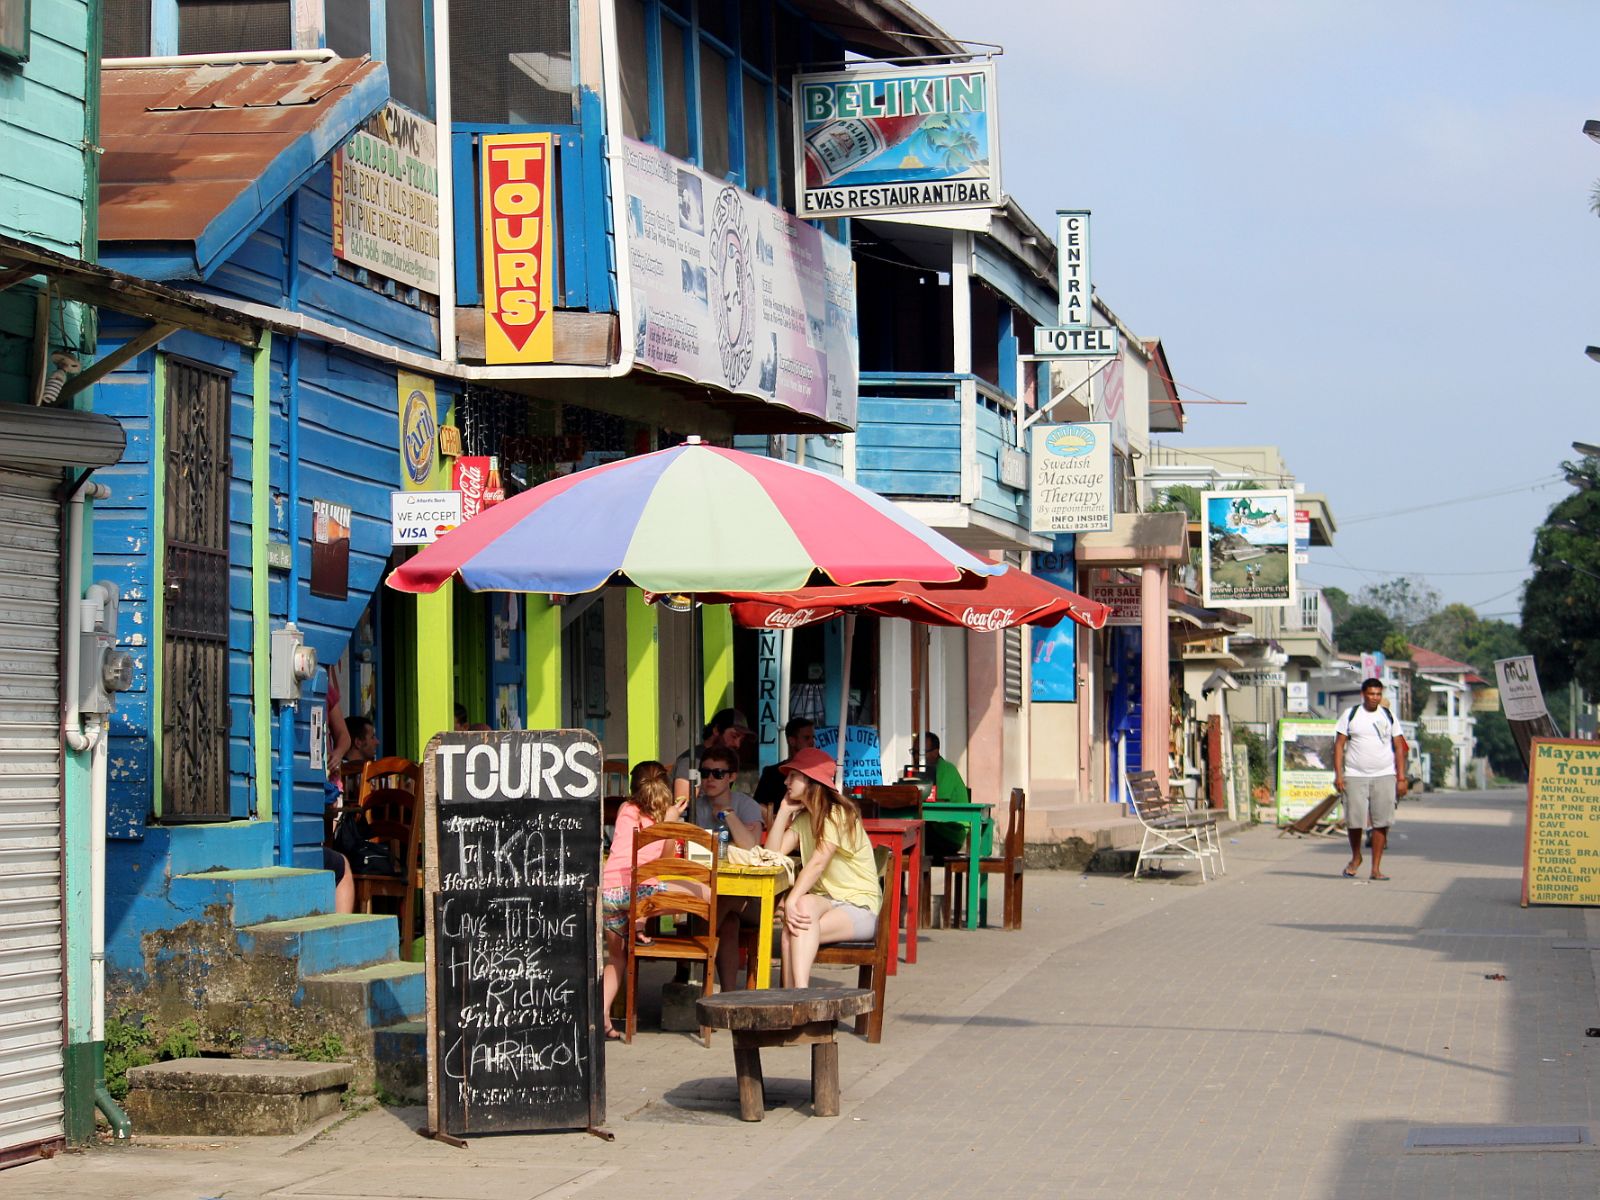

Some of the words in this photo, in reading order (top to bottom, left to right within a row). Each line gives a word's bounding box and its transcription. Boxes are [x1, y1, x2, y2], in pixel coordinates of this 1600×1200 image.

[804, 73, 985, 122] BELIKIN
[344, 163, 357, 196] BIG
[360, 170, 380, 207] ROCK
[805, 191, 844, 211] EVA'S
[358, 205, 377, 237] PINE
[491, 147, 542, 326] TOURS
[1067, 218, 1081, 323] CENTRAL
[1048, 331, 1110, 350] OTEL
[1041, 456, 1090, 470] Swedish
[1038, 472, 1104, 488] Massage
[1041, 487, 1102, 506] Therapy
[1051, 504, 1105, 514] appointment
[398, 512, 412, 521] WE
[416, 511, 456, 521] ACCEPT
[1052, 515, 1074, 523] INFO
[398, 527, 428, 538] VISA
[1094, 588, 1113, 597] FOR
[1117, 588, 1140, 597] SALE
[962, 606, 1015, 631] Coca-Cola
[852, 759, 881, 767] HOTEL
[436, 742, 599, 801] TOURS
[852, 769, 882, 777] CLEAN
[1542, 777, 1577, 785] ACTUN
[1541, 785, 1586, 794] MUKNAL
[1539, 812, 1583, 821] BARTON
[1538, 821, 1566, 829] CAVE
[1539, 830, 1590, 838] CARACOL
[1538, 838, 1571, 847] TIKAL
[1537, 856, 1577, 865] TUBING
[1537, 866, 1574, 874] MACAL
[1536, 874, 1592, 883] CANOEING
[1536, 883, 1579, 892] BIRDING
[1536, 892, 1575, 901] AIRPORT
